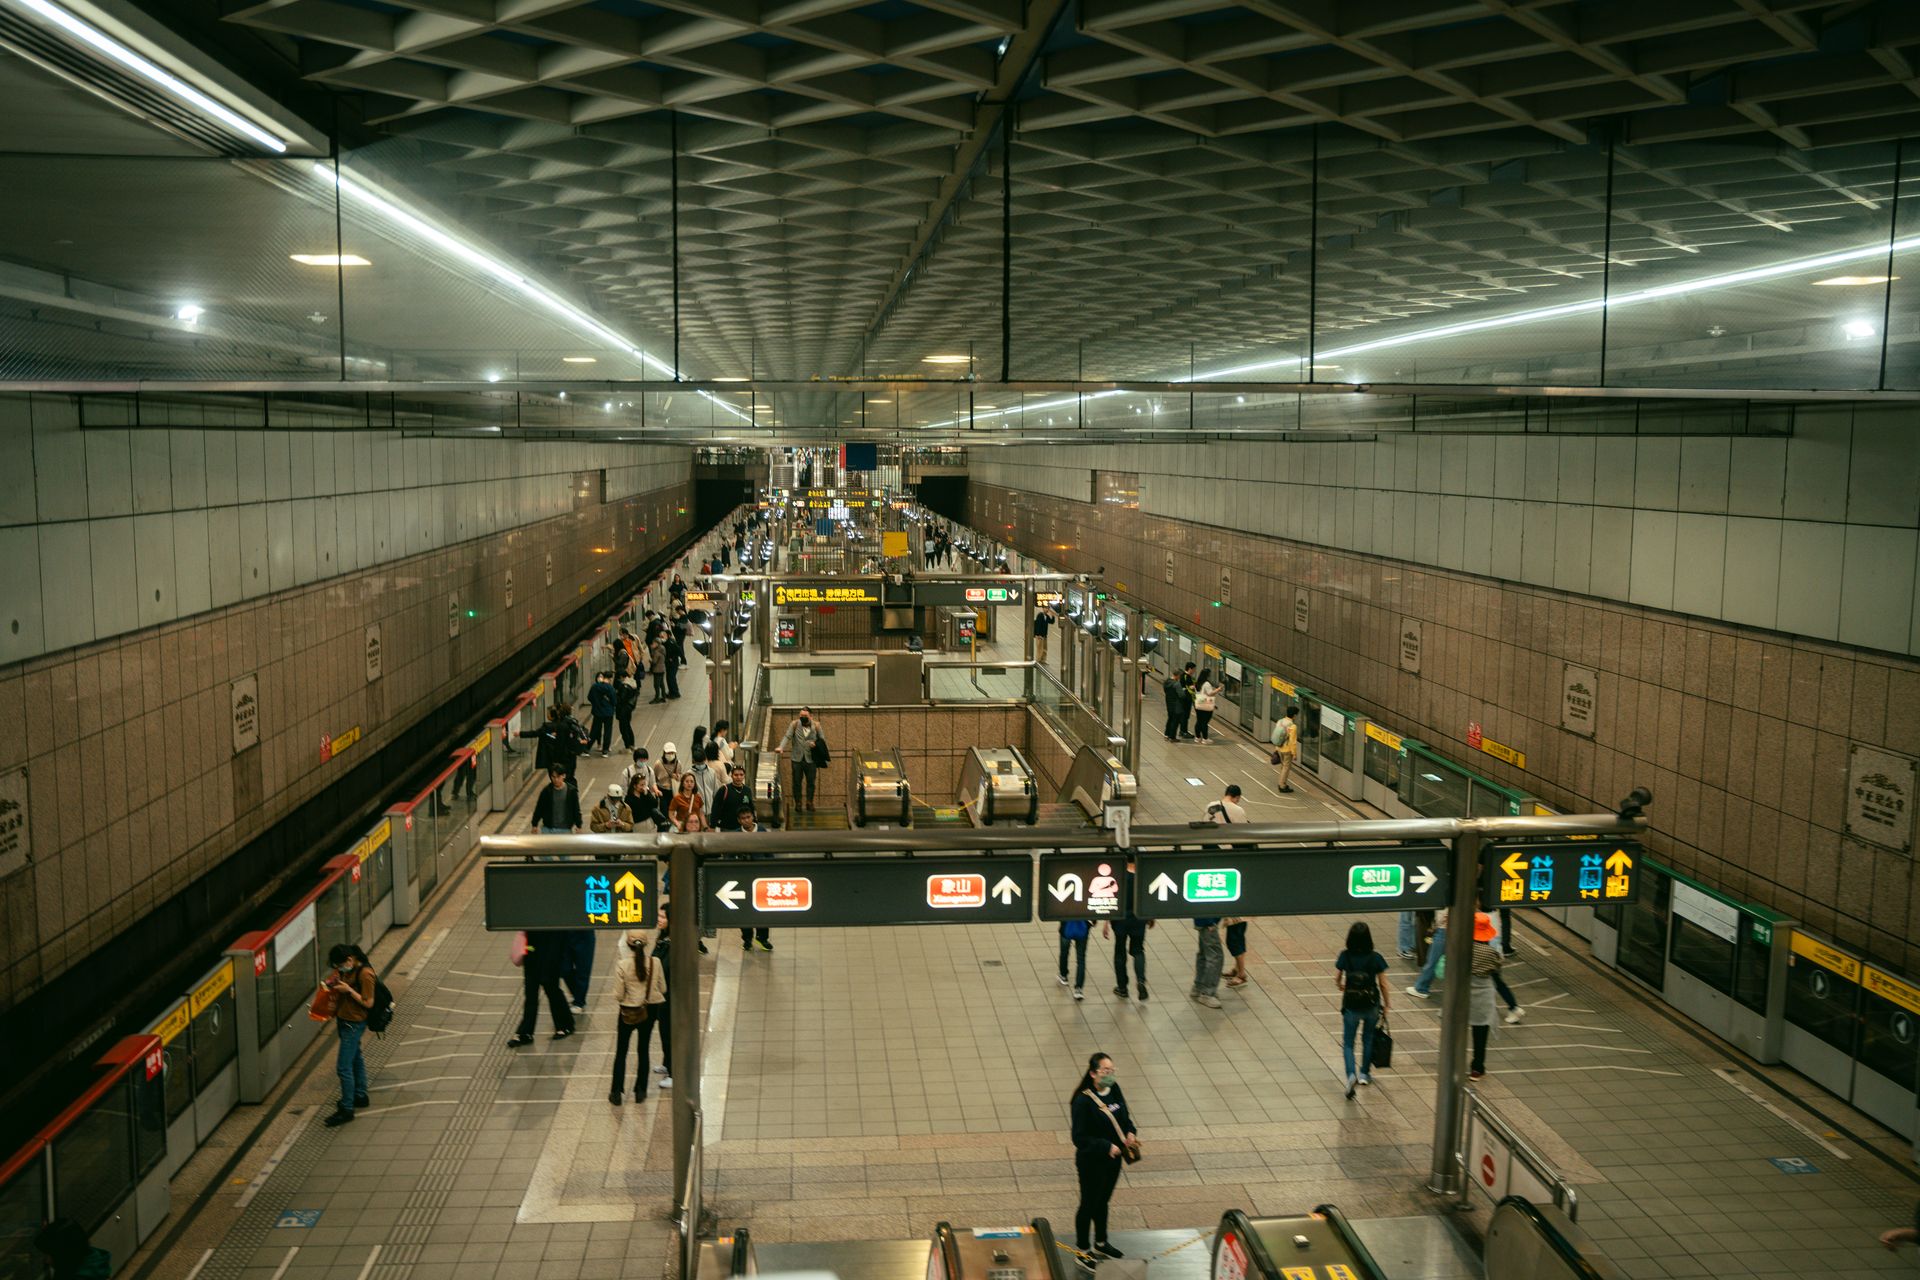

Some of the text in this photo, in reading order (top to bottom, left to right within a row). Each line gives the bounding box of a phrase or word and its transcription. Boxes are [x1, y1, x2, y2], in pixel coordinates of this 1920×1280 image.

[1197, 873, 1227, 889] 新店
[1362, 869, 1391, 884] 松山
[766, 882, 798, 897] 淡水
[941, 879, 971, 894] 象山
[1580, 888, 1599, 899] 1-4
[1530, 890, 1550, 901] 5-7
[588, 913, 609, 924] 1-4
[1765, 928, 1770, 943] 1
